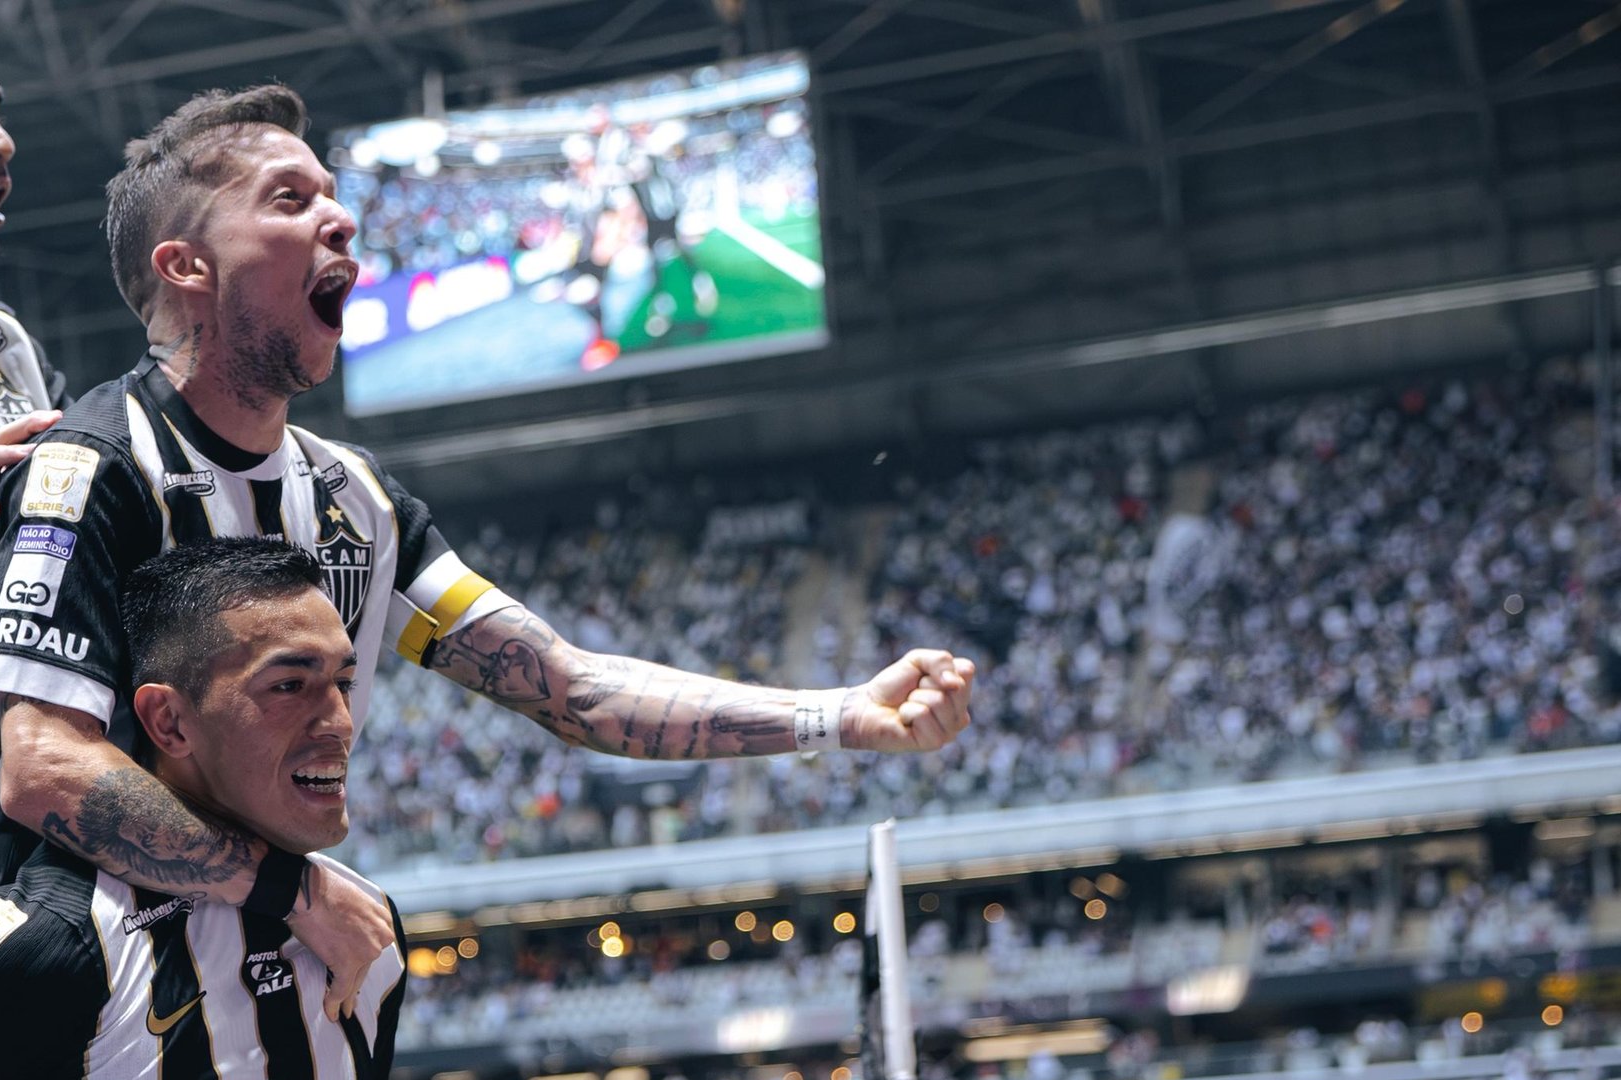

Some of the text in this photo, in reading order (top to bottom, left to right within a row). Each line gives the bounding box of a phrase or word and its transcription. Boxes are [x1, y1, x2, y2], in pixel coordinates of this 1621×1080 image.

[65, 506, 76, 516] A
[21, 528, 51, 538] NÃO AO
[17, 540, 69, 556] FEMINICÍDIO
[320, 549, 367, 565] CAM
[246, 950, 278, 963] POSTOS
[255, 974, 293, 997] ALE
